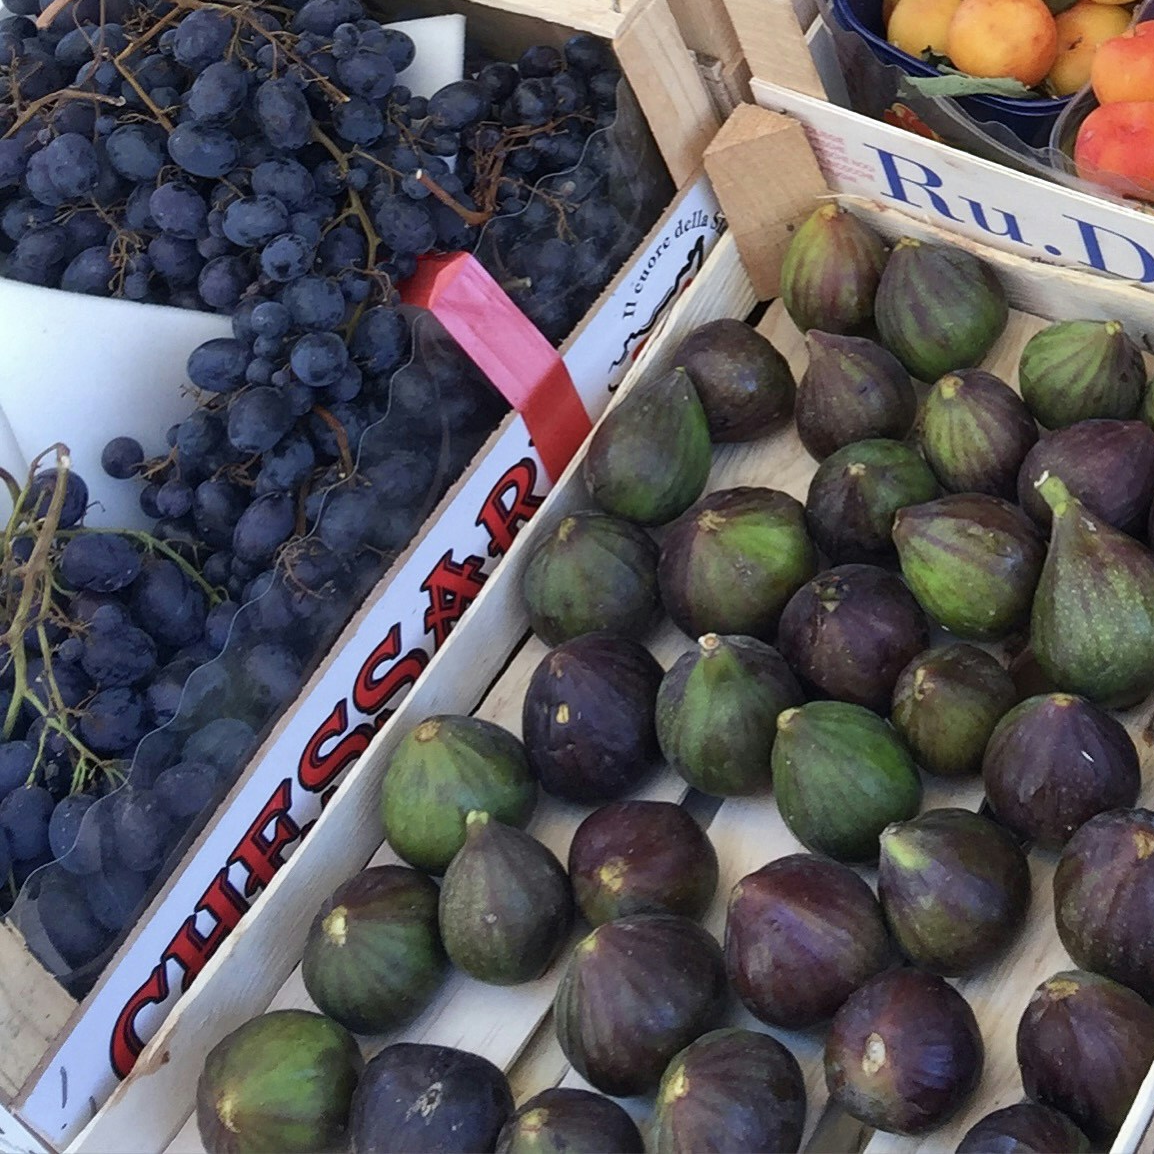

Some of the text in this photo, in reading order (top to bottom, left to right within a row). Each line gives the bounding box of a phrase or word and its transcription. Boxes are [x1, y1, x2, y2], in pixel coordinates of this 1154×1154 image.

[622, 301, 637, 320] Il
[634, 236, 670, 294] cuore
[673, 208, 709, 239] della
[108, 438, 552, 1082] CHESSAR
